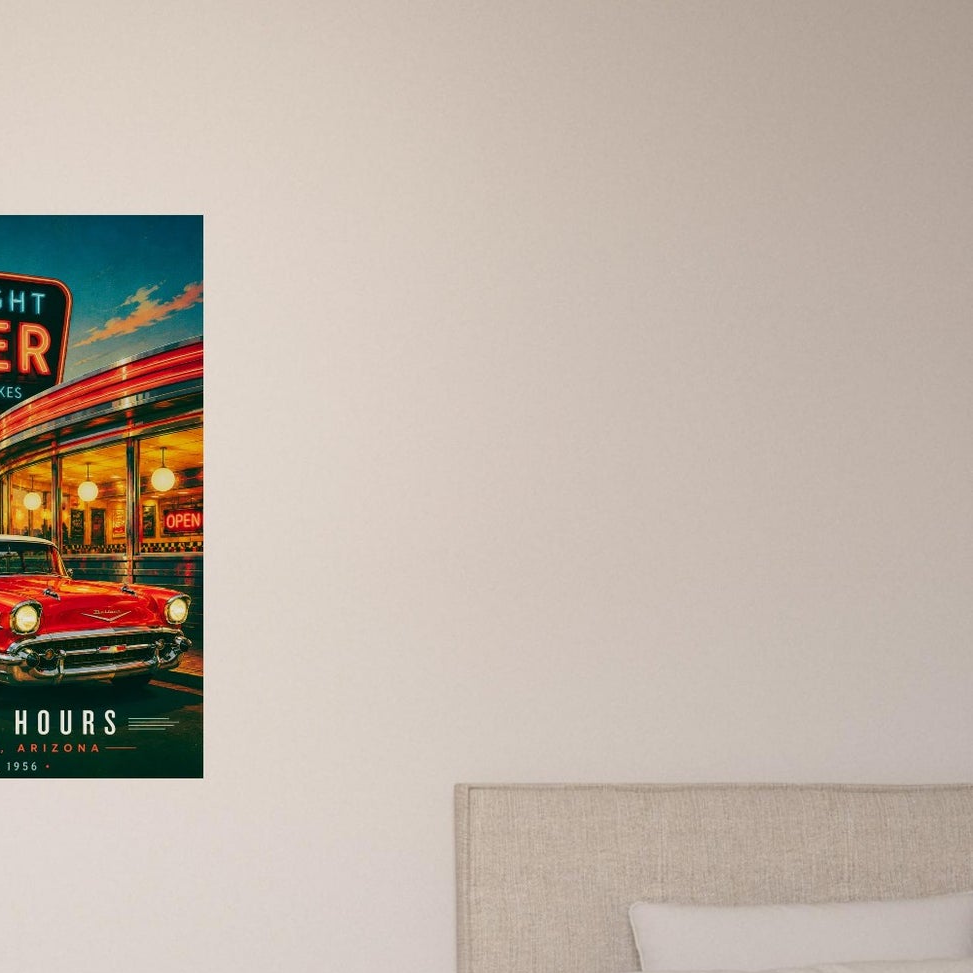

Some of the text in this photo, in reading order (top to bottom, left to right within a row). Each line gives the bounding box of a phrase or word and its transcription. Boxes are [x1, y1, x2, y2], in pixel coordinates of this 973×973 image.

[166, 512, 201, 529] OPEN
[14, 709, 116, 735] HOURS
[17, 743, 99, 753] ARIZONA
[6, 761, 37, 771] 1956
